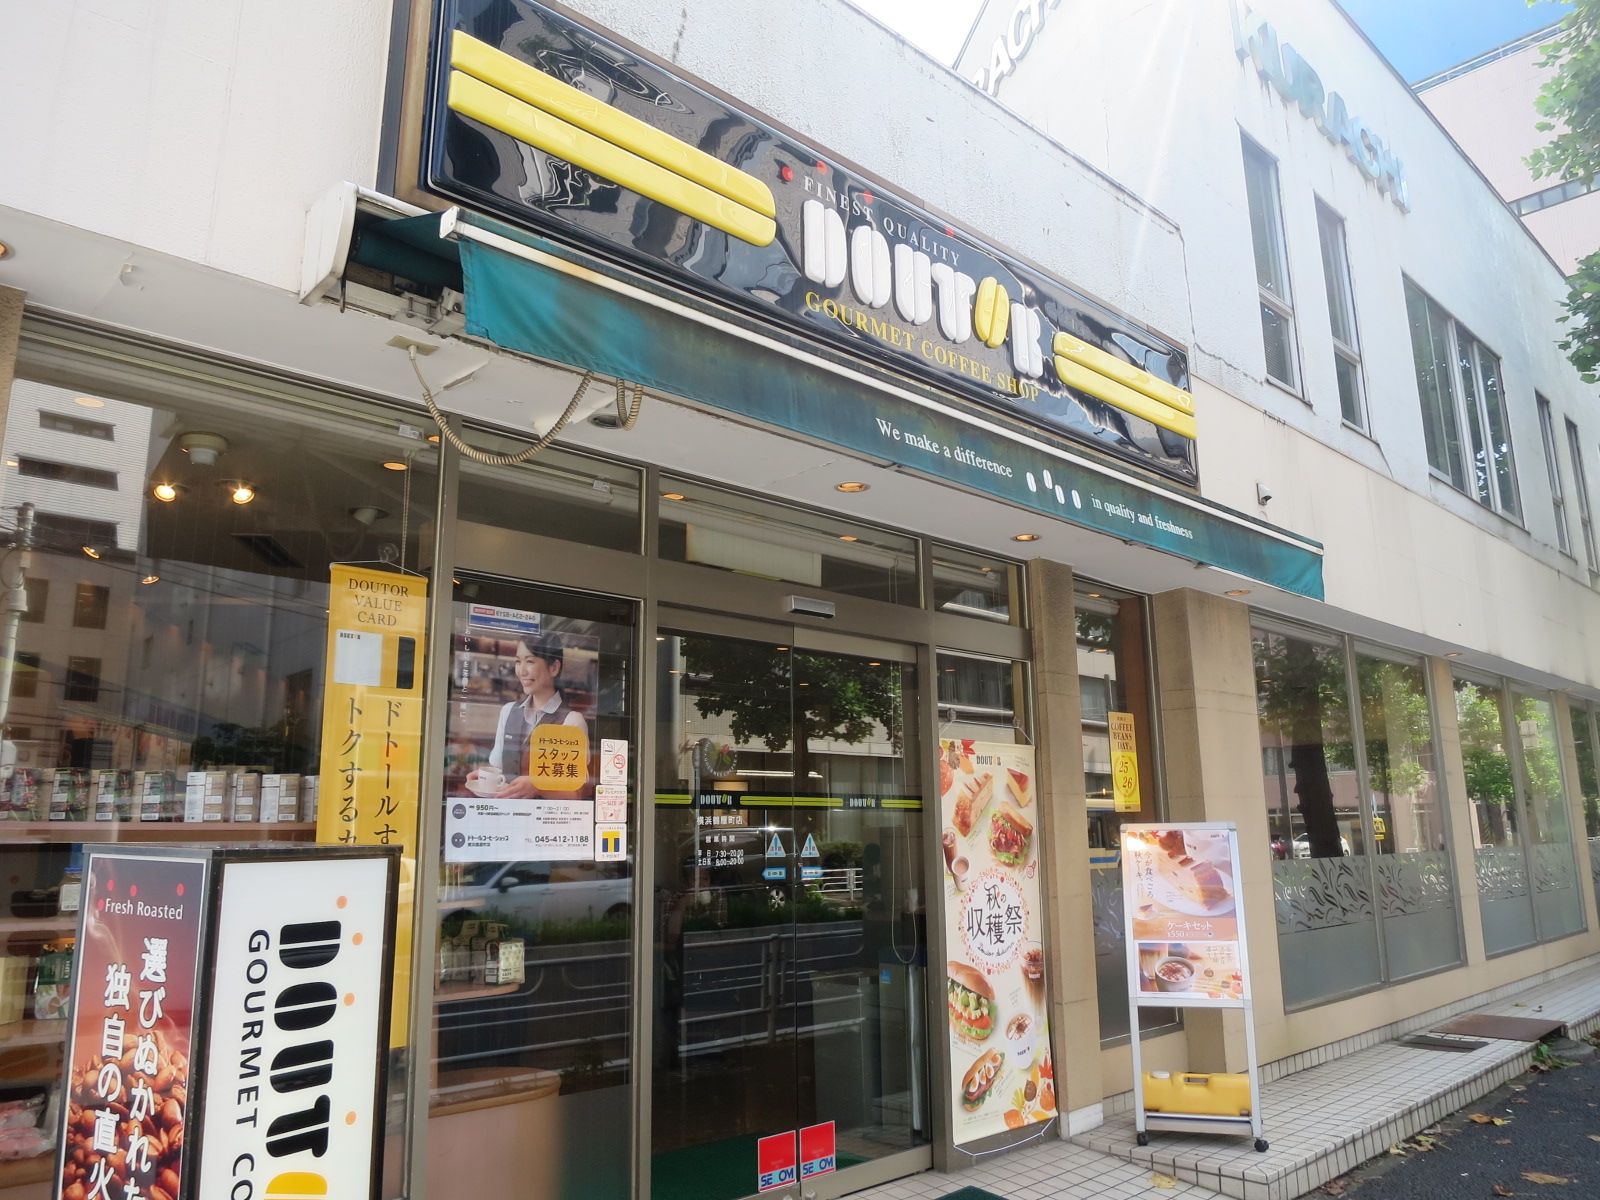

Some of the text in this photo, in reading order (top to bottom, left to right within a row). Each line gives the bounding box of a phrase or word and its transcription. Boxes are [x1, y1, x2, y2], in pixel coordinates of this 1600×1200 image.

[804, 175, 960, 267] FINEST QUALITY
[803, 199, 1044, 379] DOUTOR
[805, 291, 1039, 401] GOURMET COFFEE SHOP
[876, 417, 1193, 540] We make a difference in quality and freshness
[349, 578, 409, 598] DOUTOR
[355, 594, 403, 612] VALUE
[357, 611, 397, 627] CARD
[1111, 723, 1132, 732] COFFEE
[1113, 732, 1132, 741] BEANS
[538, 748, 580, 760] スタッフ
[537, 763, 579, 779] 大募集
[1119, 760, 1129, 773] 25
[1122, 776, 1132, 789] 26
[700, 794, 733, 805] DOUTOR
[535, 835, 589, 843] 045-412-1188
[984, 882, 1007, 910] 秋の
[105, 898, 184, 920] Fresh Roasted
[967, 904, 1022, 945] 収穫祭
[1168, 921, 1213, 931] ケーキセット
[236, 929, 270, 1128] GOURMET
[87, 963, 131, 1200] 独自の直火
